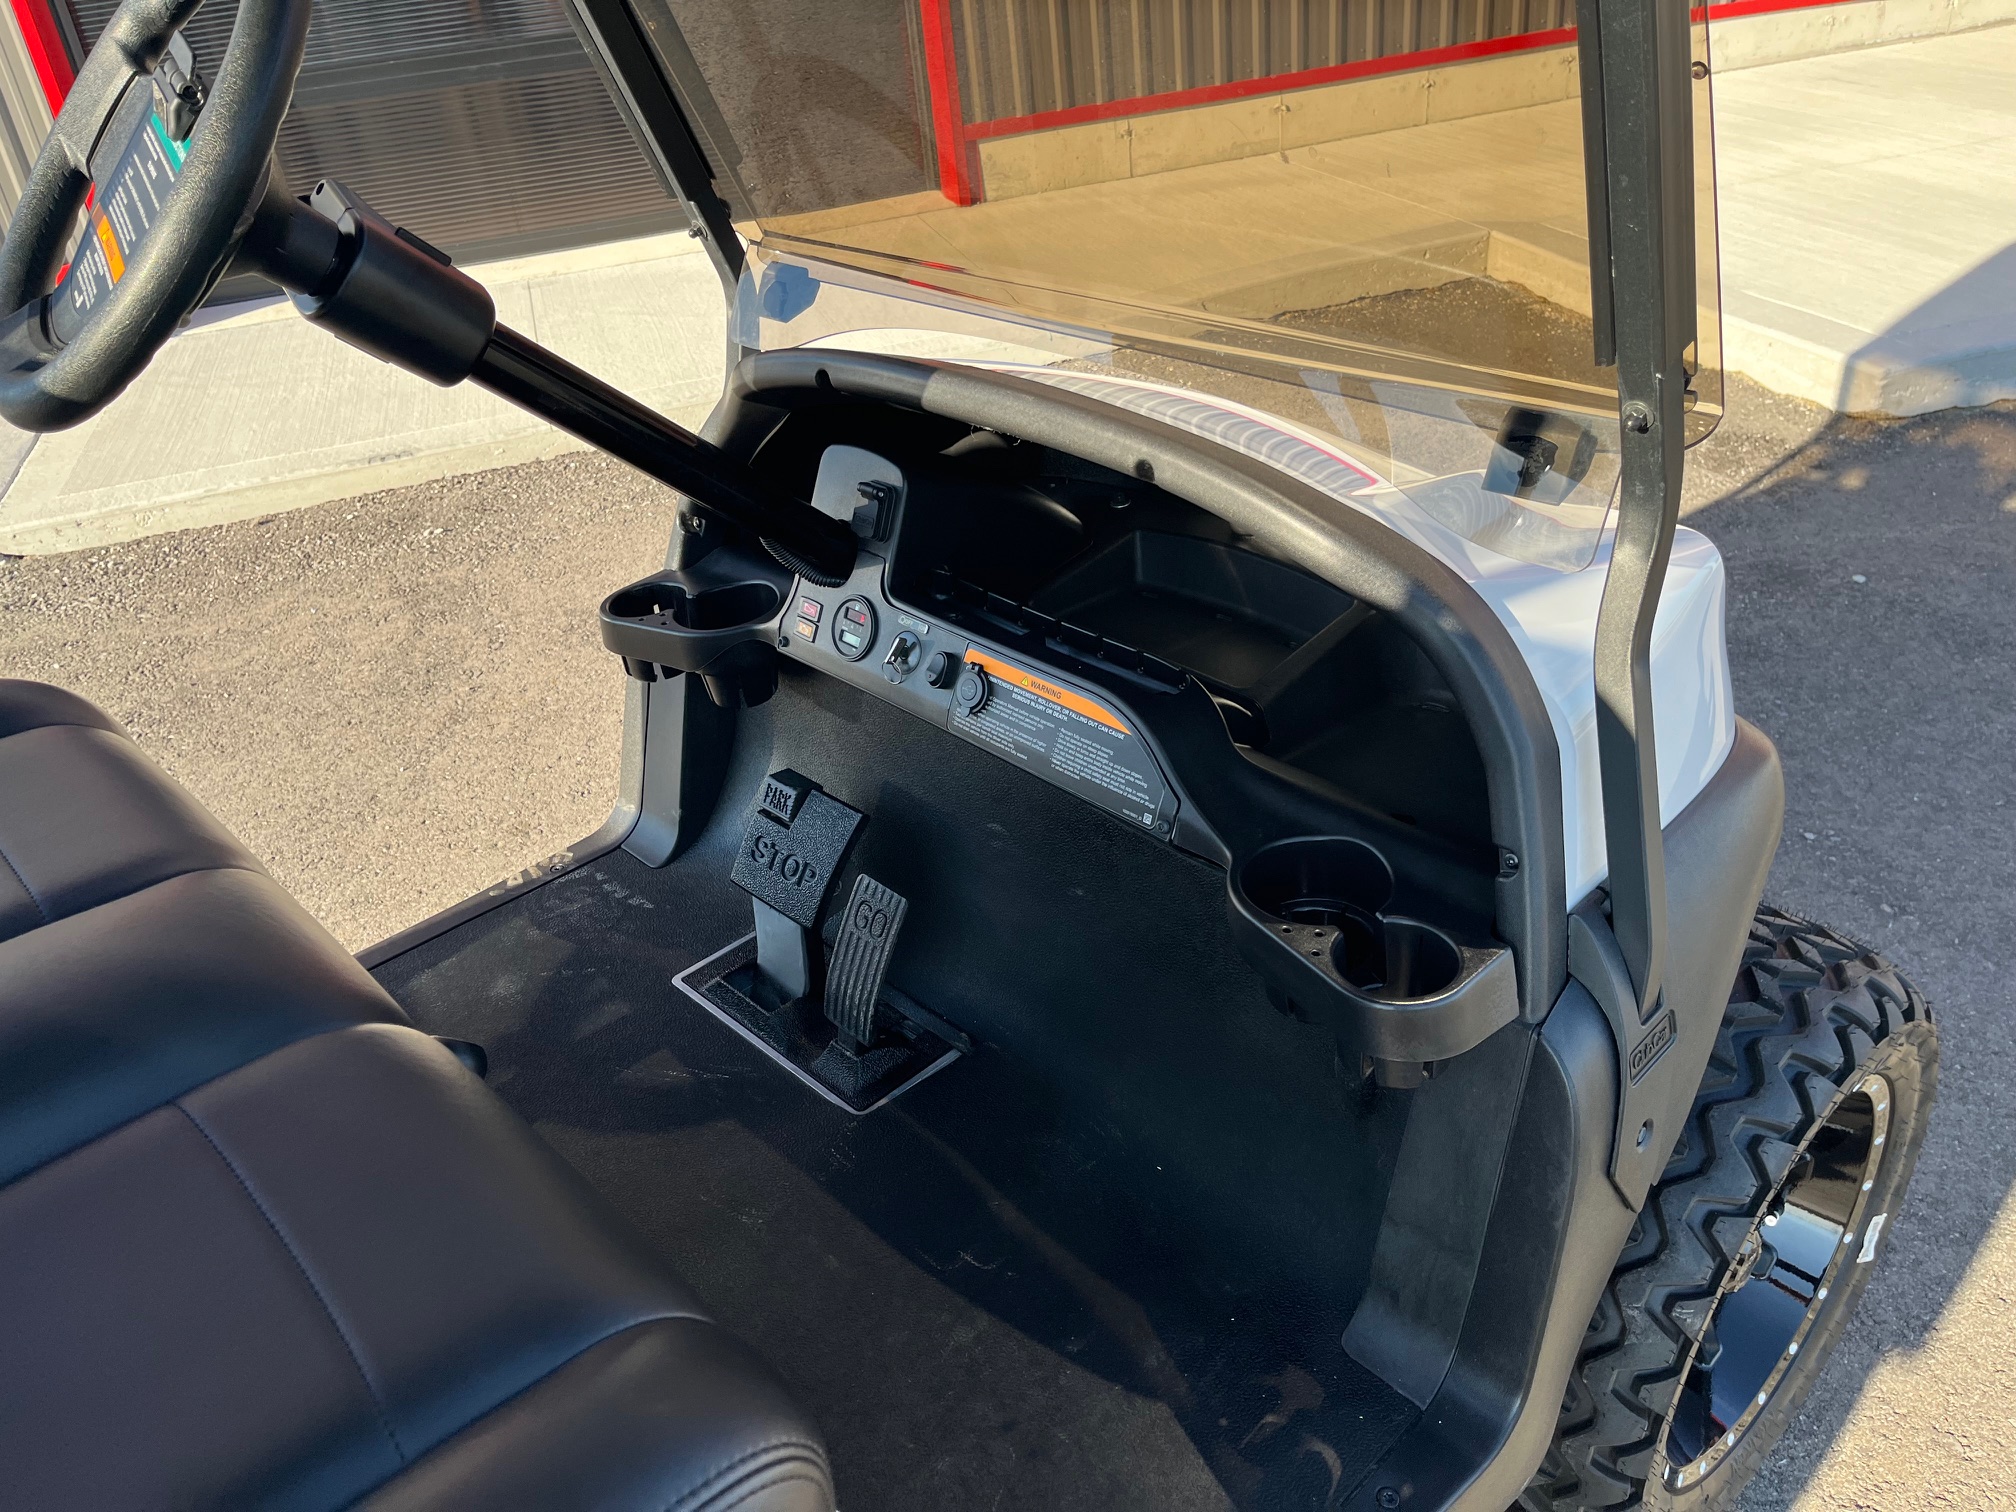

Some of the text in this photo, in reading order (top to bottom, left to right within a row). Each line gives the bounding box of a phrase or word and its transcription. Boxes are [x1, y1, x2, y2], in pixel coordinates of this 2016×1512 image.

[1011, 693, 1030, 704] SERIOUS
[1030, 701, 1045, 711] INJURY
[1031, 681, 1062, 699] WARNING
[1037, 697, 1061, 711] ROLLOVER,
[1069, 711, 1087, 723] FALLING
[1097, 724, 1107, 732] CAN
[1108, 729, 1124, 739] CAUSE
[763, 782, 793, 816] PARK
[751, 835, 819, 887] STOP
[855, 900, 888, 940] GO
